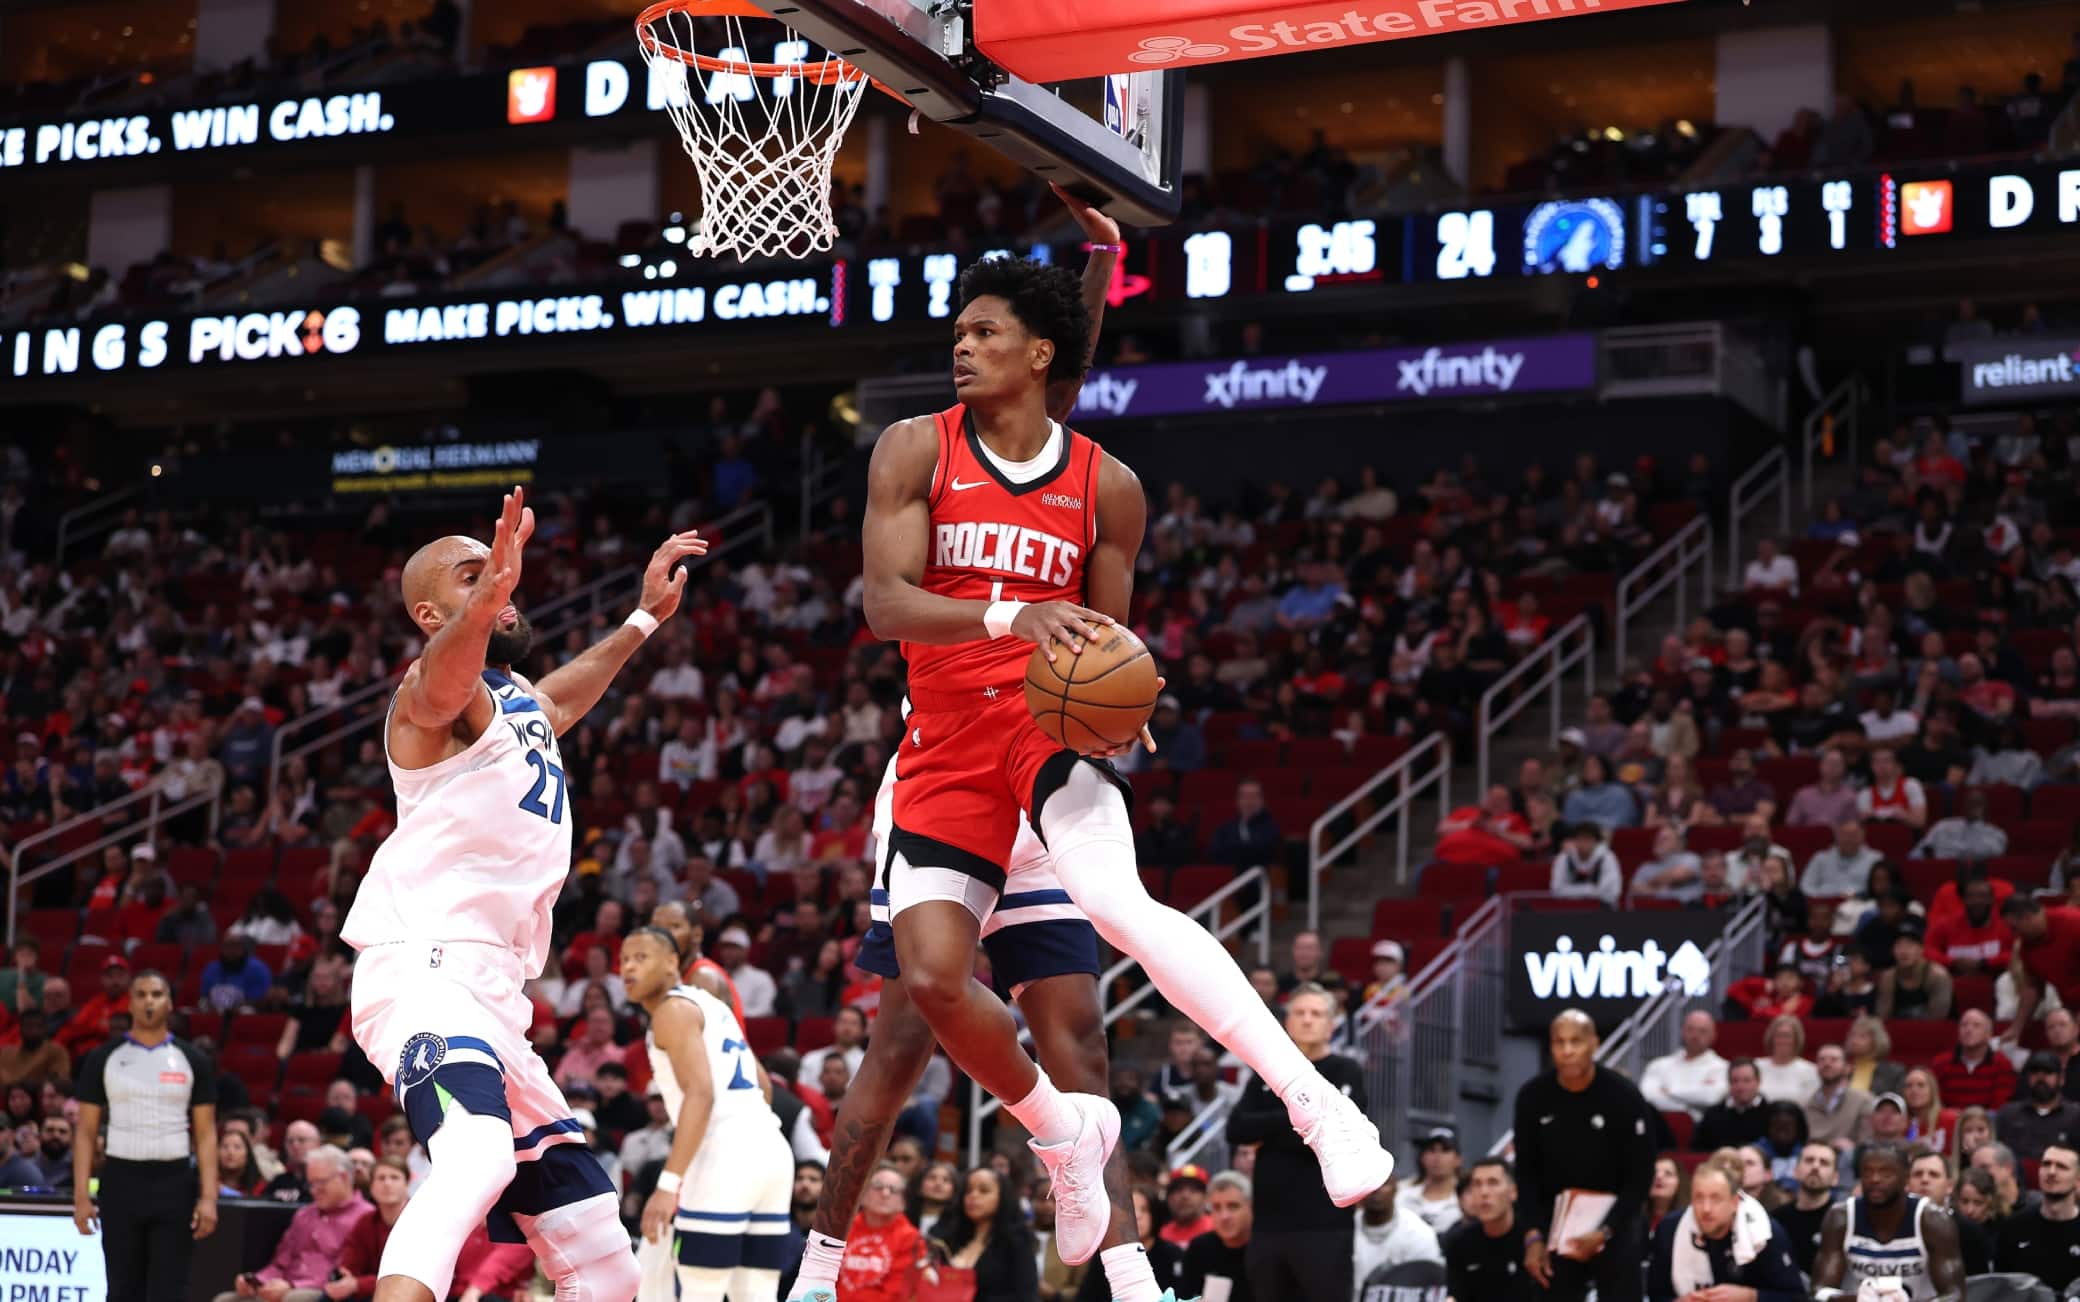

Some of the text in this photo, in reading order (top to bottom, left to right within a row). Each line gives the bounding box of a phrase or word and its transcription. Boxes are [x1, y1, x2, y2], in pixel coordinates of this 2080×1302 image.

[1230, 11, 1417, 51] State
[586, 40, 857, 116] DRAF
[0, 92, 394, 167] E PICKS. WIN CASH.
[1436, 210, 1496, 279] 24
[1693, 219, 1715, 260] 7
[0, 321, 169, 376] INGS
[384, 303, 490, 344] MAKE
[495, 295, 614, 336] PICKS.
[622, 287, 706, 327] WIN
[713, 278, 830, 320] CASH.
[1205, 360, 1327, 408] xfinity
[1398, 347, 1524, 395] xfinity
[1973, 352, 2073, 388] reliant
[936, 522, 1079, 588] ROCKETS
[518, 748, 564, 824] 27
[1524, 935, 1667, 998] vivint
[0, 1247, 78, 1275] NDAY
[1851, 1262, 1923, 1277] WOLVES
[10, 1284, 50, 1302] PM
